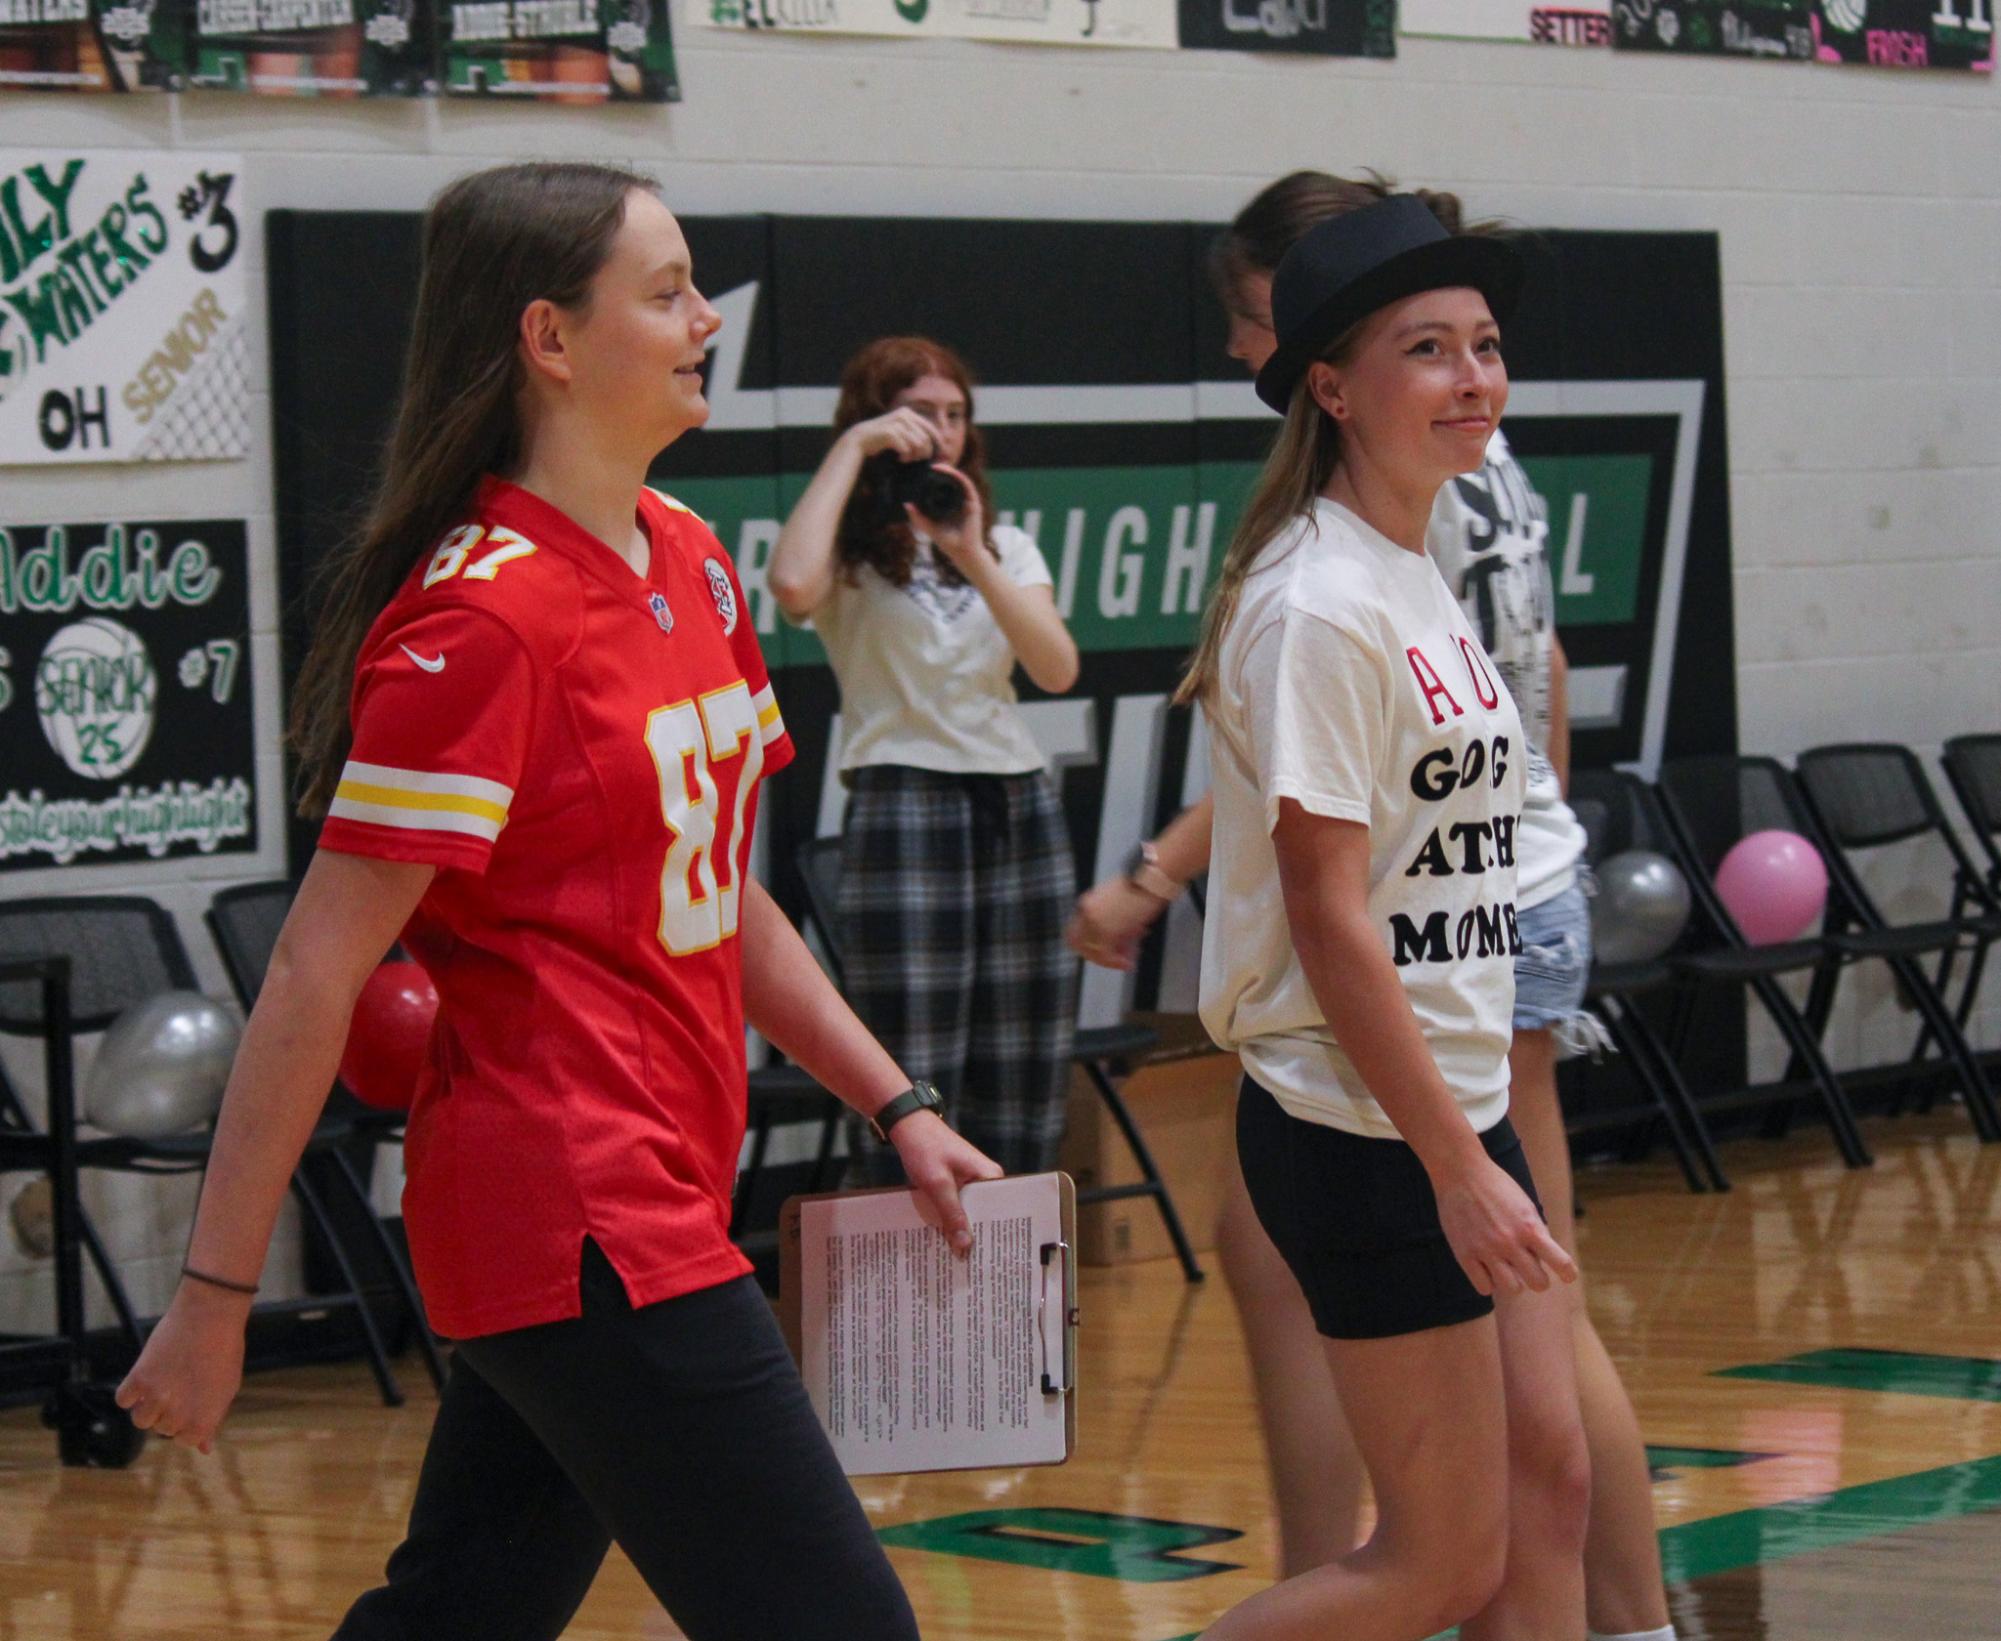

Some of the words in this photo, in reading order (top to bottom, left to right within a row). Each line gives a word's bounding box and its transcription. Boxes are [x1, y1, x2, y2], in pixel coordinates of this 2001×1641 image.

[176, 170, 239, 273] #3
[122, 287, 228, 425] SENIOR
[38, 385, 110, 451] OH
[422, 524, 539, 591] 87
[77, 721, 124, 766] 25
[643, 679, 765, 957] 87
